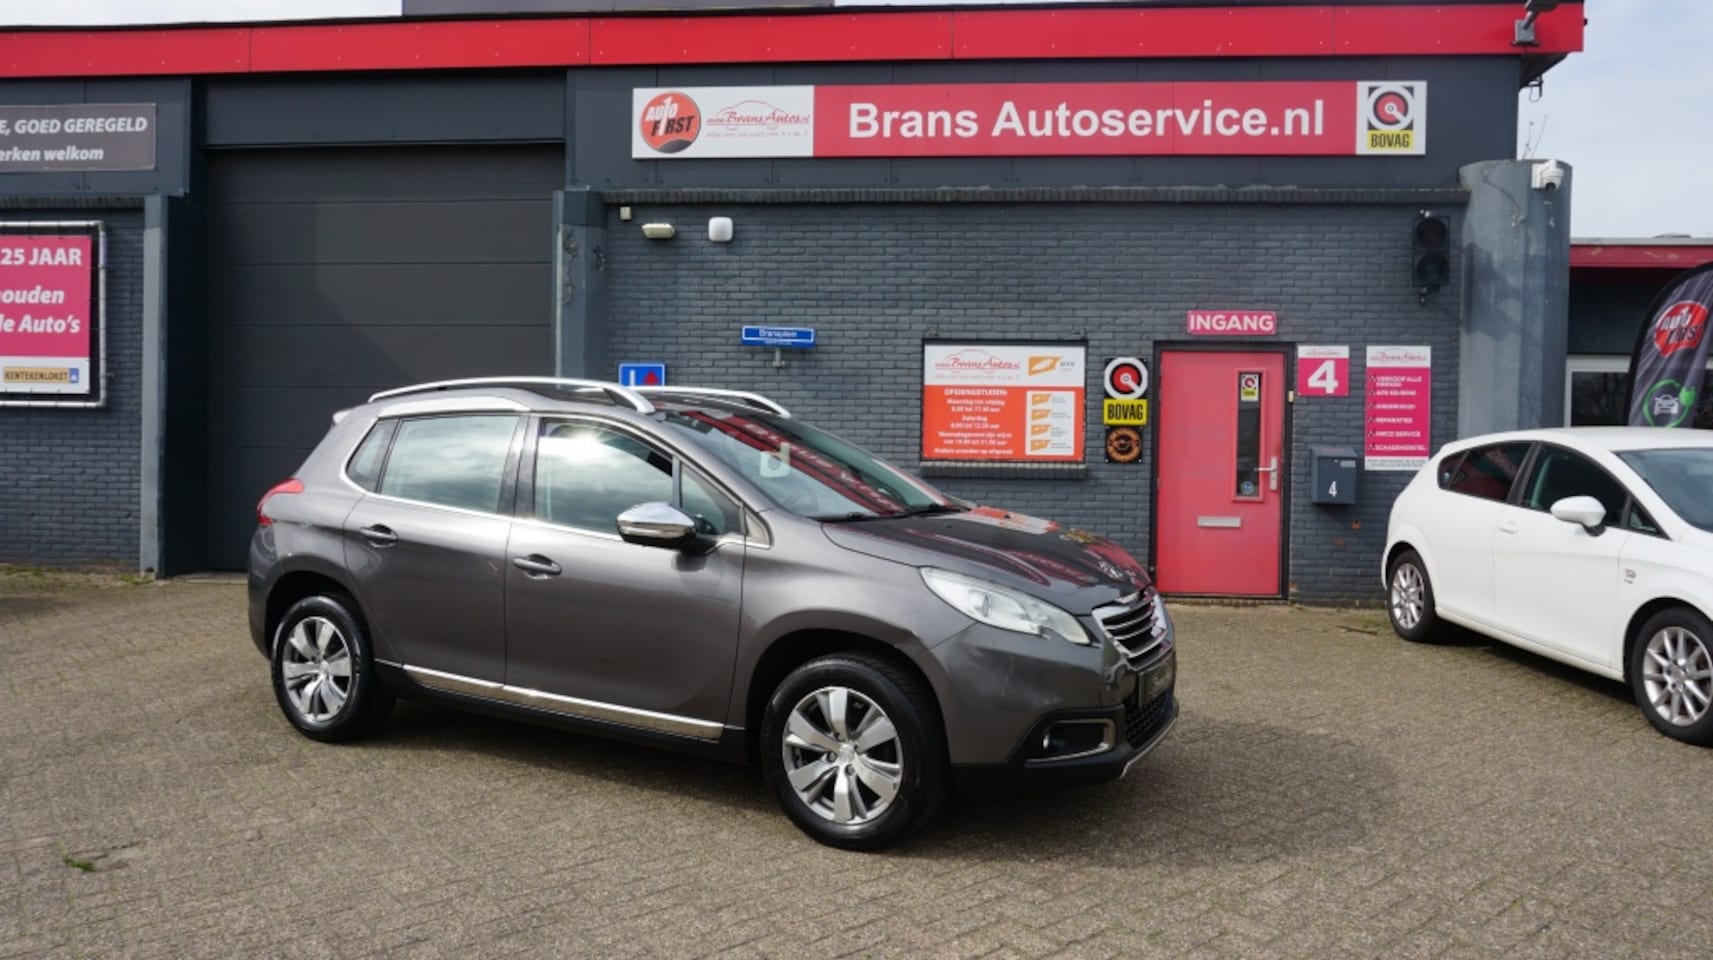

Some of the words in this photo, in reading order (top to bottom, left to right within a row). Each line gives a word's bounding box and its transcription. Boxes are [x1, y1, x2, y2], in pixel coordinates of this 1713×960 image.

[645, 101, 679, 121] AUTO
[849, 103, 979, 138] Brans
[991, 100, 1324, 137] Autoservice.nl
[14, 119, 61, 134] GOED
[64, 117, 148, 133] GEREGELD
[1371, 133, 1410, 148] BOVAG
[44, 145, 104, 160] welkom
[1, 248, 25, 265] 25
[28, 248, 82, 265] JAAR
[0, 285, 64, 304] ouden
[18, 314, 80, 333] Auto's
[1190, 314, 1274, 331] INGANG
[5, 371, 67, 380] KENTEKENLOKET
[1308, 360, 1339, 394] 4
[1107, 403, 1144, 421] BOVAG
[1328, 480, 1338, 498] 4
